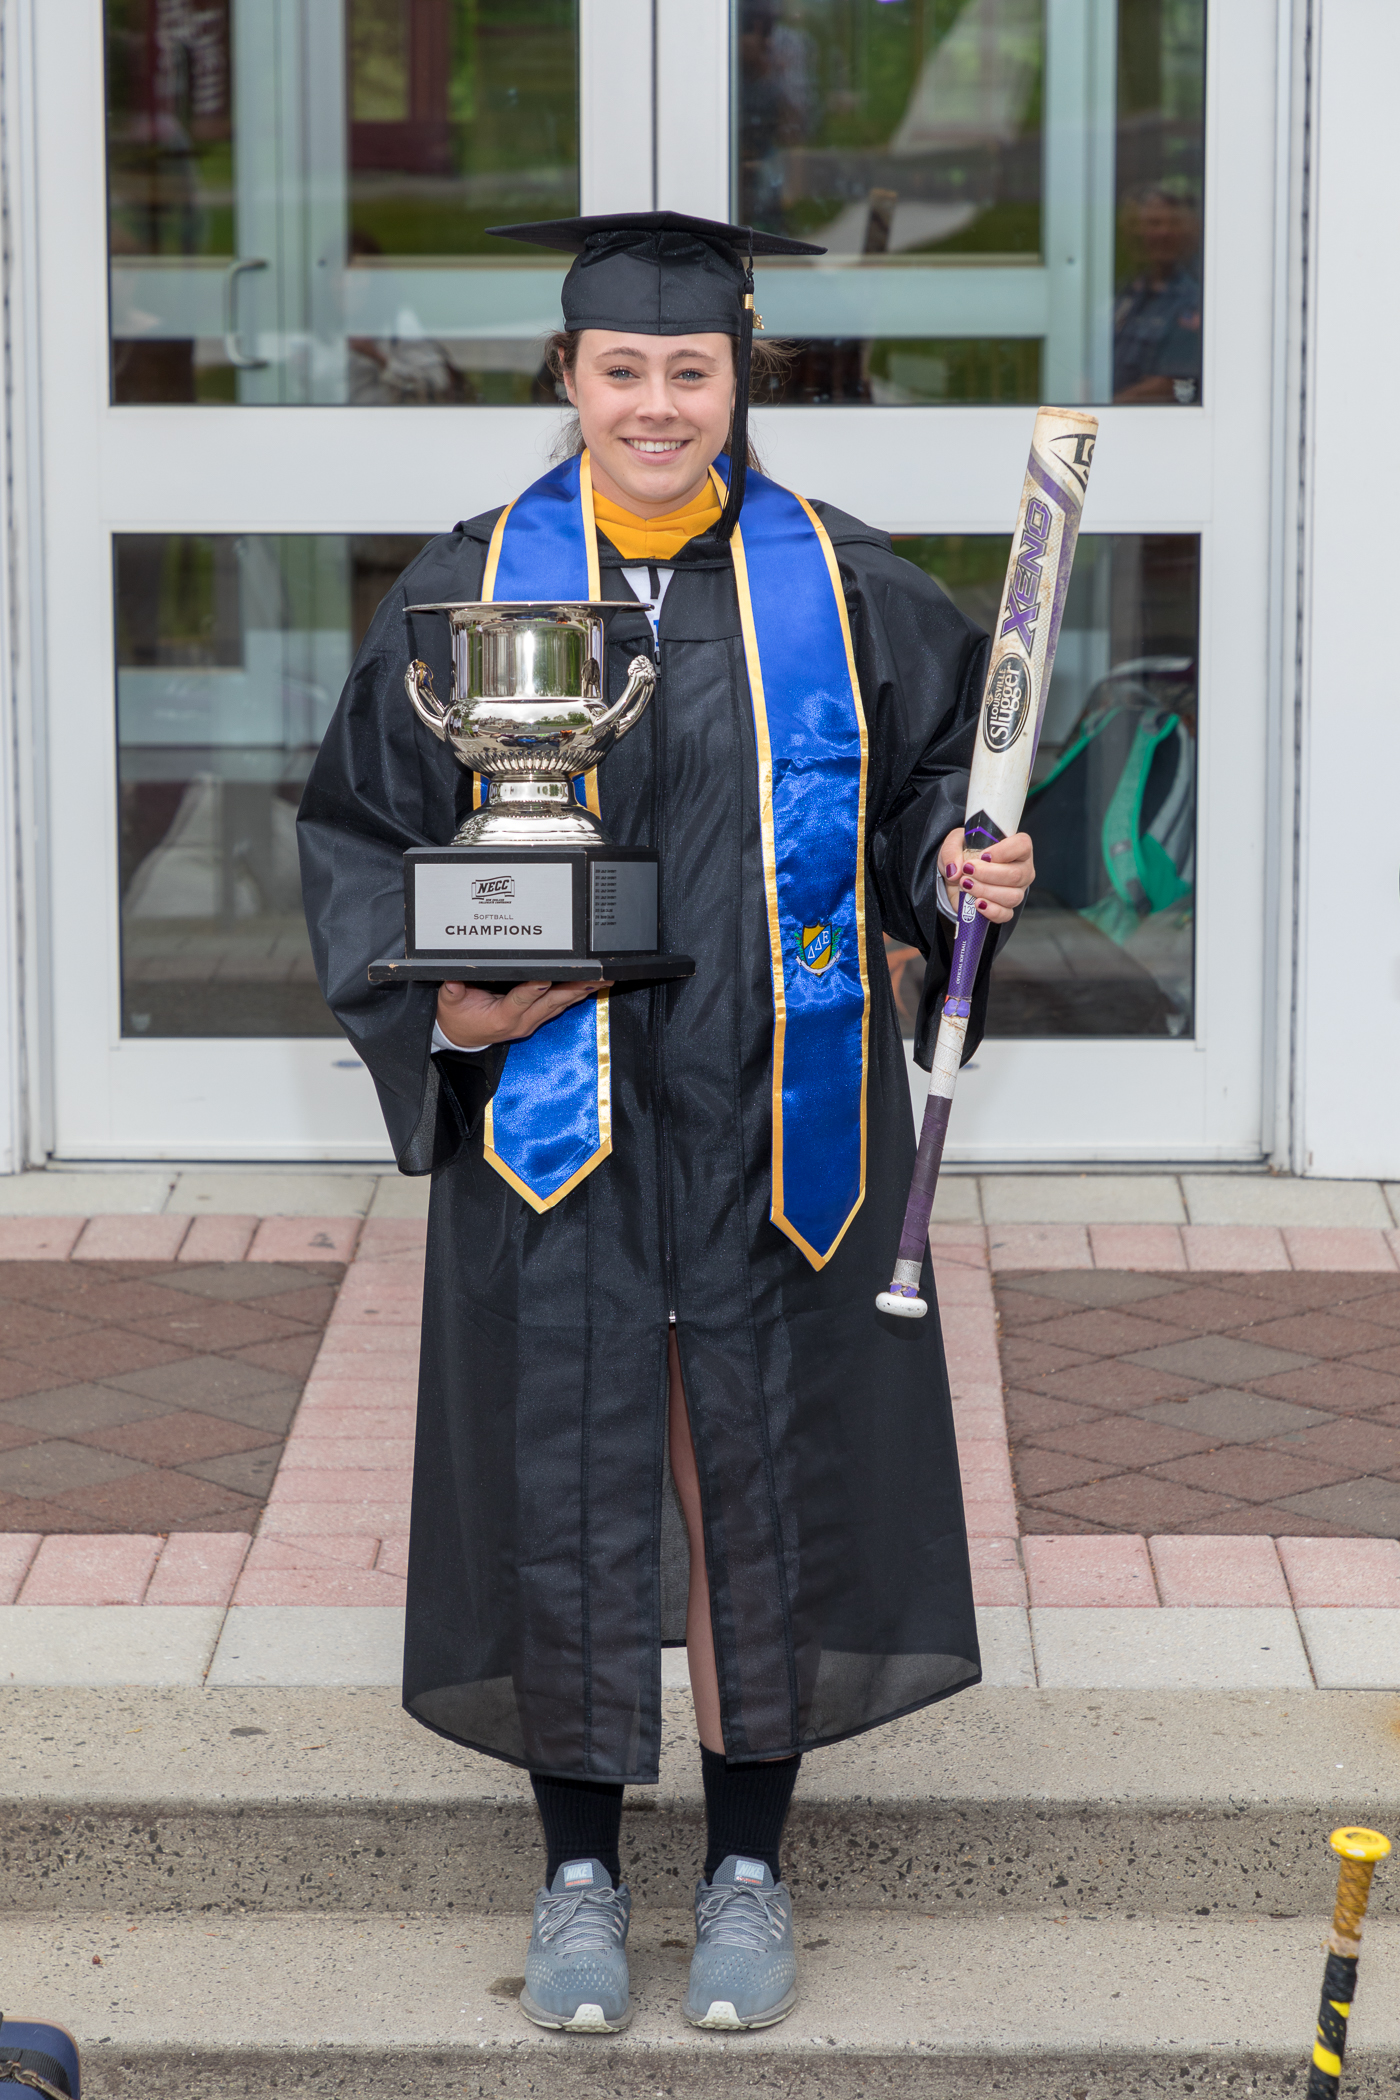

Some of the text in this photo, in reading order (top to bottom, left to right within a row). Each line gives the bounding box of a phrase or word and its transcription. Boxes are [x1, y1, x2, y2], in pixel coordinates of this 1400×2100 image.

[1000, 497, 1052, 657] XENO
[990, 668, 1007, 720] LOUISVILLE
[989, 664, 1022, 740] Slugger
[478, 880, 509, 893] NECC
[445, 925, 542, 936] CHAMPIONS
[567, 1866, 588, 1879] NIKE
[739, 1864, 761, 1876] NIKE
